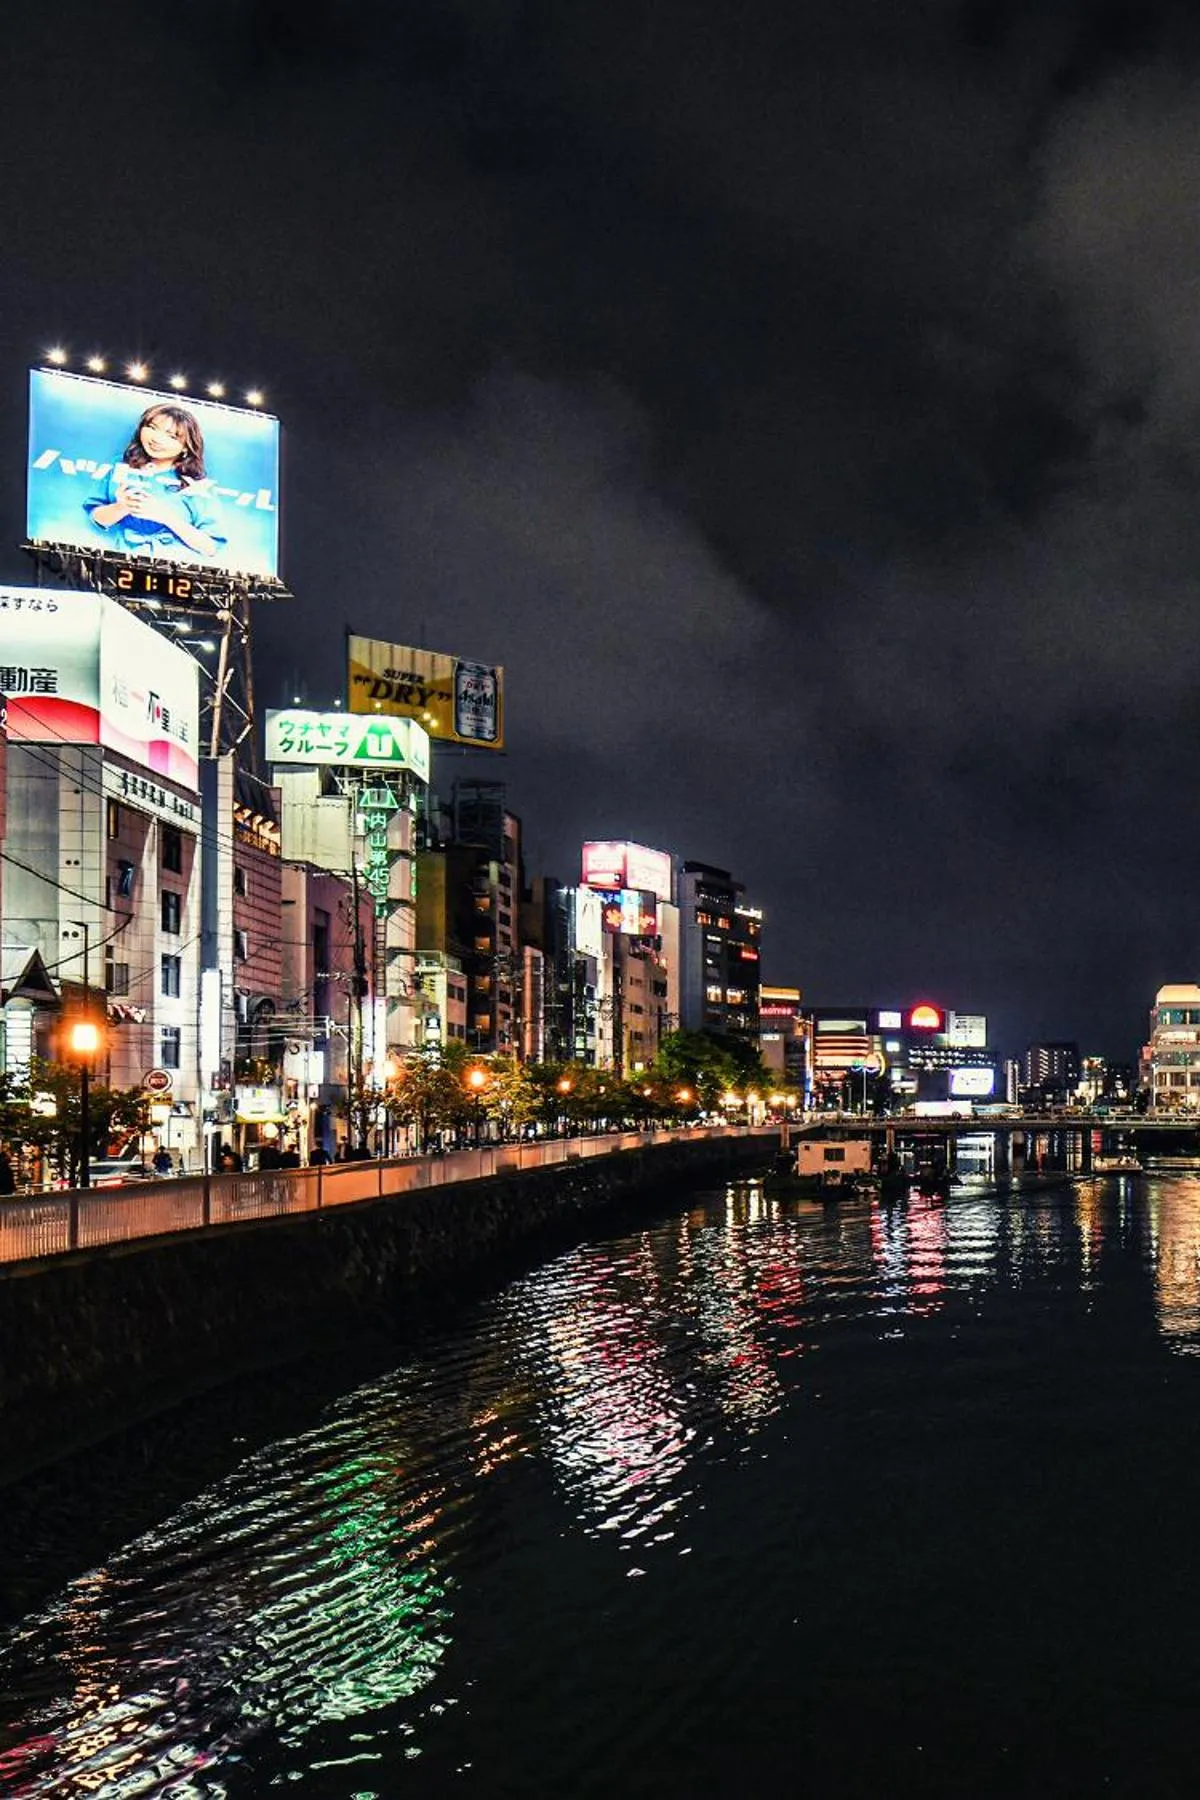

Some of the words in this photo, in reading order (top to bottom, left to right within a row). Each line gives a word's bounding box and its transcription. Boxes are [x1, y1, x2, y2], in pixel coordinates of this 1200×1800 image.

[117, 570, 191, 597] 21:12
[383, 667, 425, 685] SUPER
[279, 719, 350, 737] ウチヤマ
